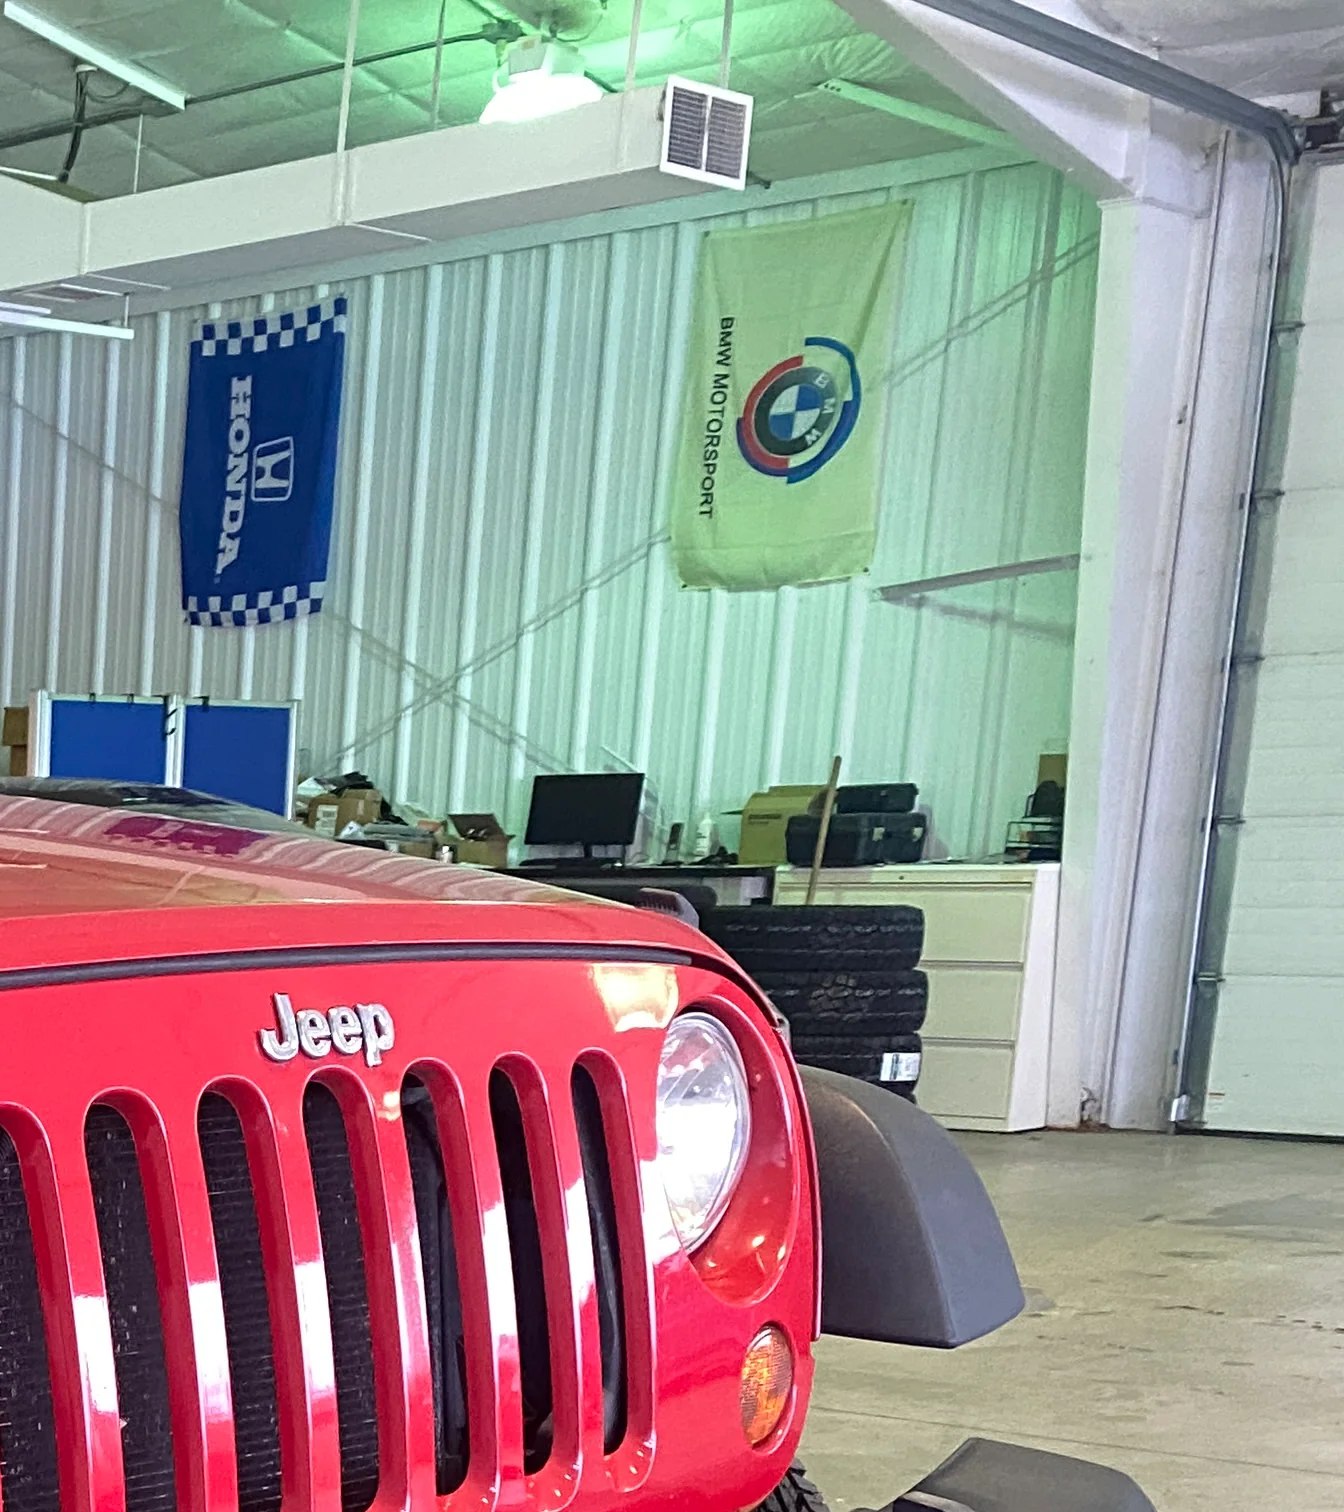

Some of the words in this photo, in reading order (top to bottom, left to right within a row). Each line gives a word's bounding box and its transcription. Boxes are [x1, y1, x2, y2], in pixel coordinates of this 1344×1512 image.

[716, 316, 734, 367] BMW
[215, 374, 253, 576] HONDA
[699, 372, 730, 519] MOTORSPORT
[258, 992, 395, 1067] Jeep
